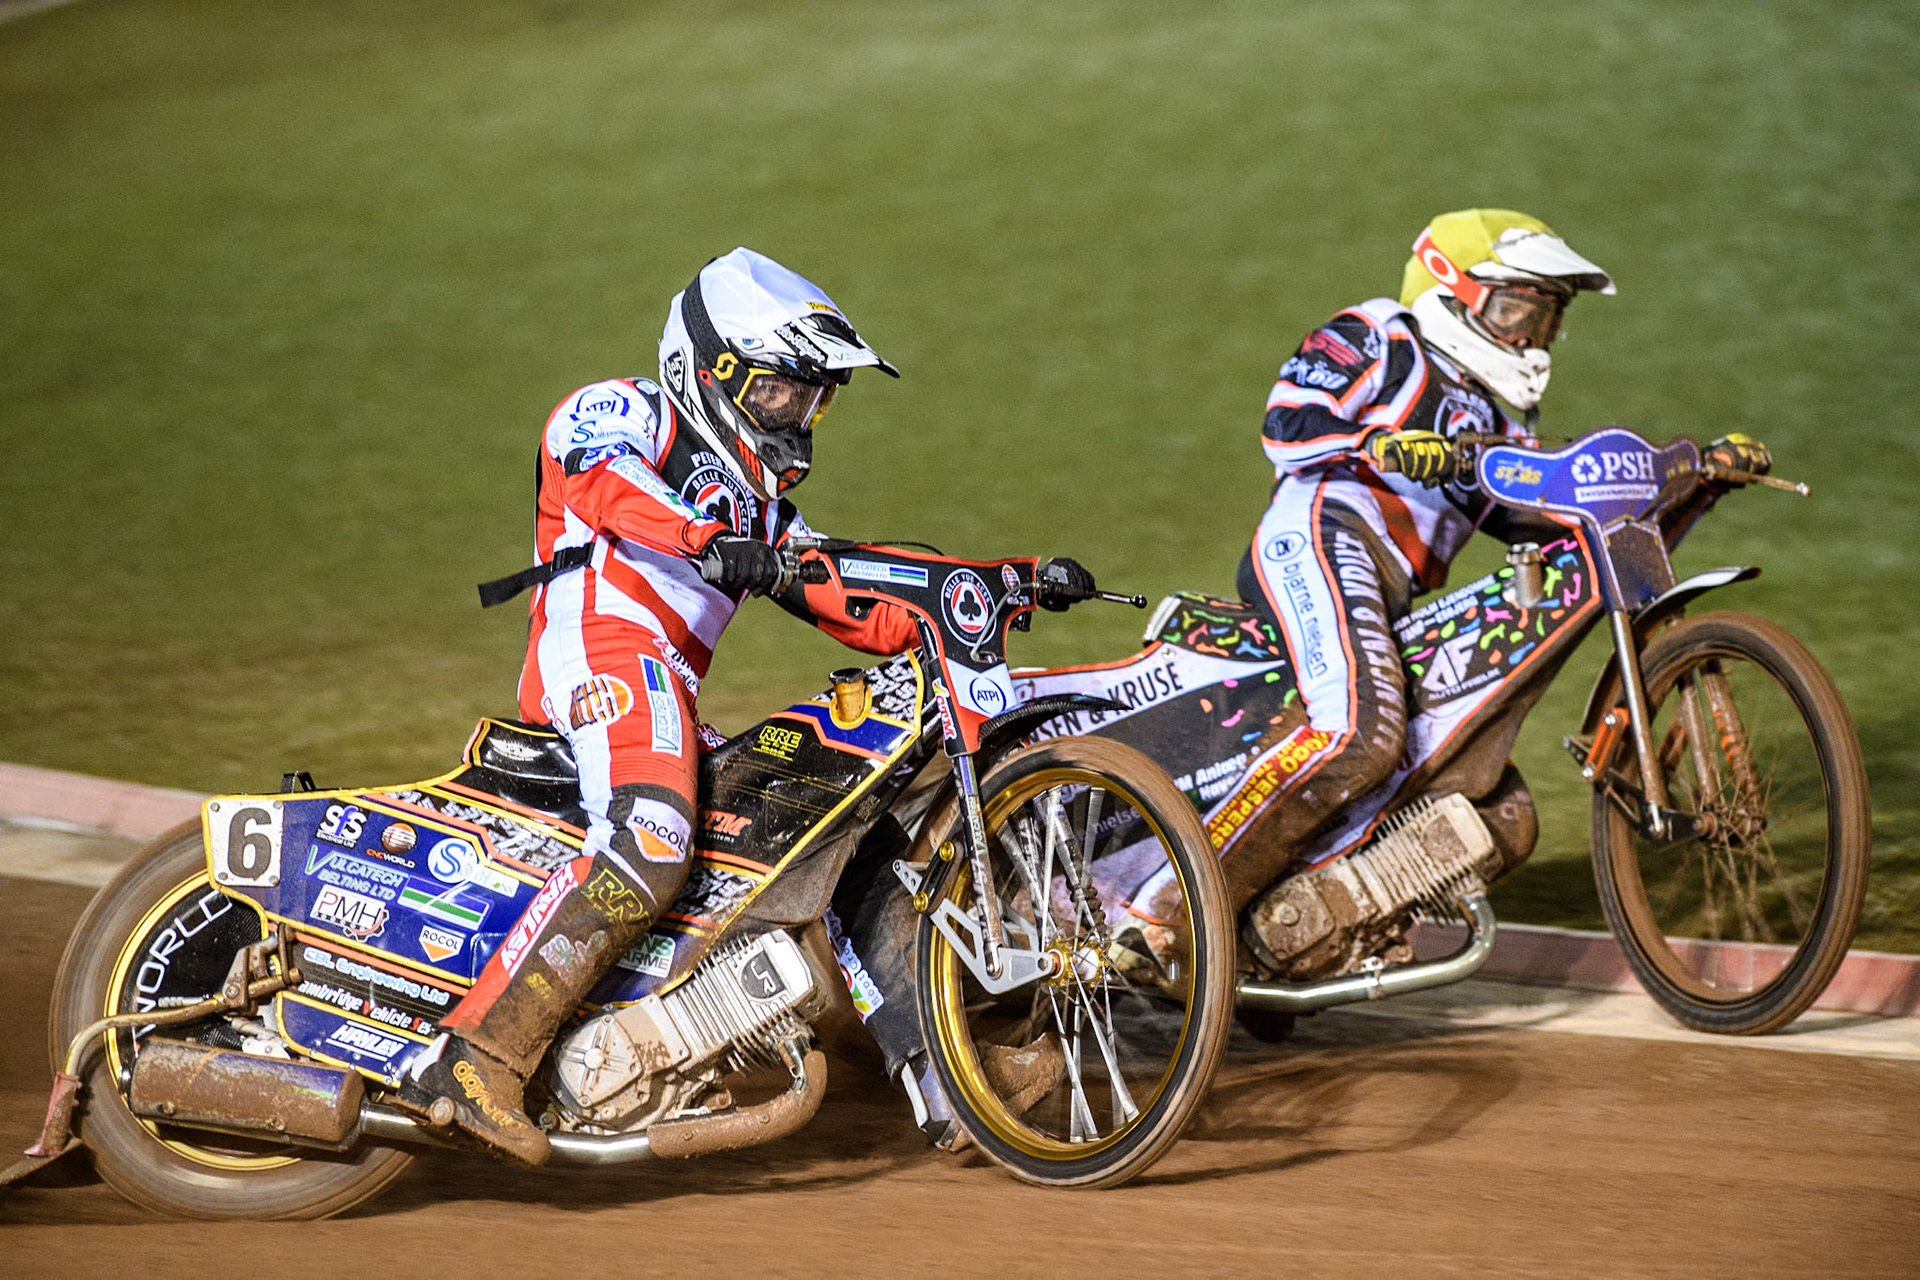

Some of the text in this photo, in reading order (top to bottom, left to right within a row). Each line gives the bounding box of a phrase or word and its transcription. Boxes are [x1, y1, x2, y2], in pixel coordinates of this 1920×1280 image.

[1600, 452, 1655, 480] PSH
[691, 471, 720, 490] BELLE
[723, 475, 739, 498] VUE
[944, 574, 961, 599] BELLE
[961, 573, 975, 582] VUE
[1283, 560, 1315, 616] bjarne
[976, 688, 1000, 702] ATPI
[1107, 662, 1184, 715] KRUSE
[759, 725, 803, 749] RRE
[228, 808, 272, 881] 6
[633, 816, 684, 853] ROCOL
[303, 844, 405, 888] VULCATECH
[365, 848, 416, 869] CNCWORLD
[317, 868, 397, 902] BELTING LTD
[317, 890, 383, 926] PMH
[421, 929, 461, 950] ROCOL
[335, 957, 422, 998] Engineering
[420, 985, 450, 1006] Ltd
[297, 979, 364, 1011] ambridge
[362, 1000, 414, 1029] Vehicle
[330, 1024, 405, 1058] HAYLEY
[452, 1060, 529, 1131] daytona
